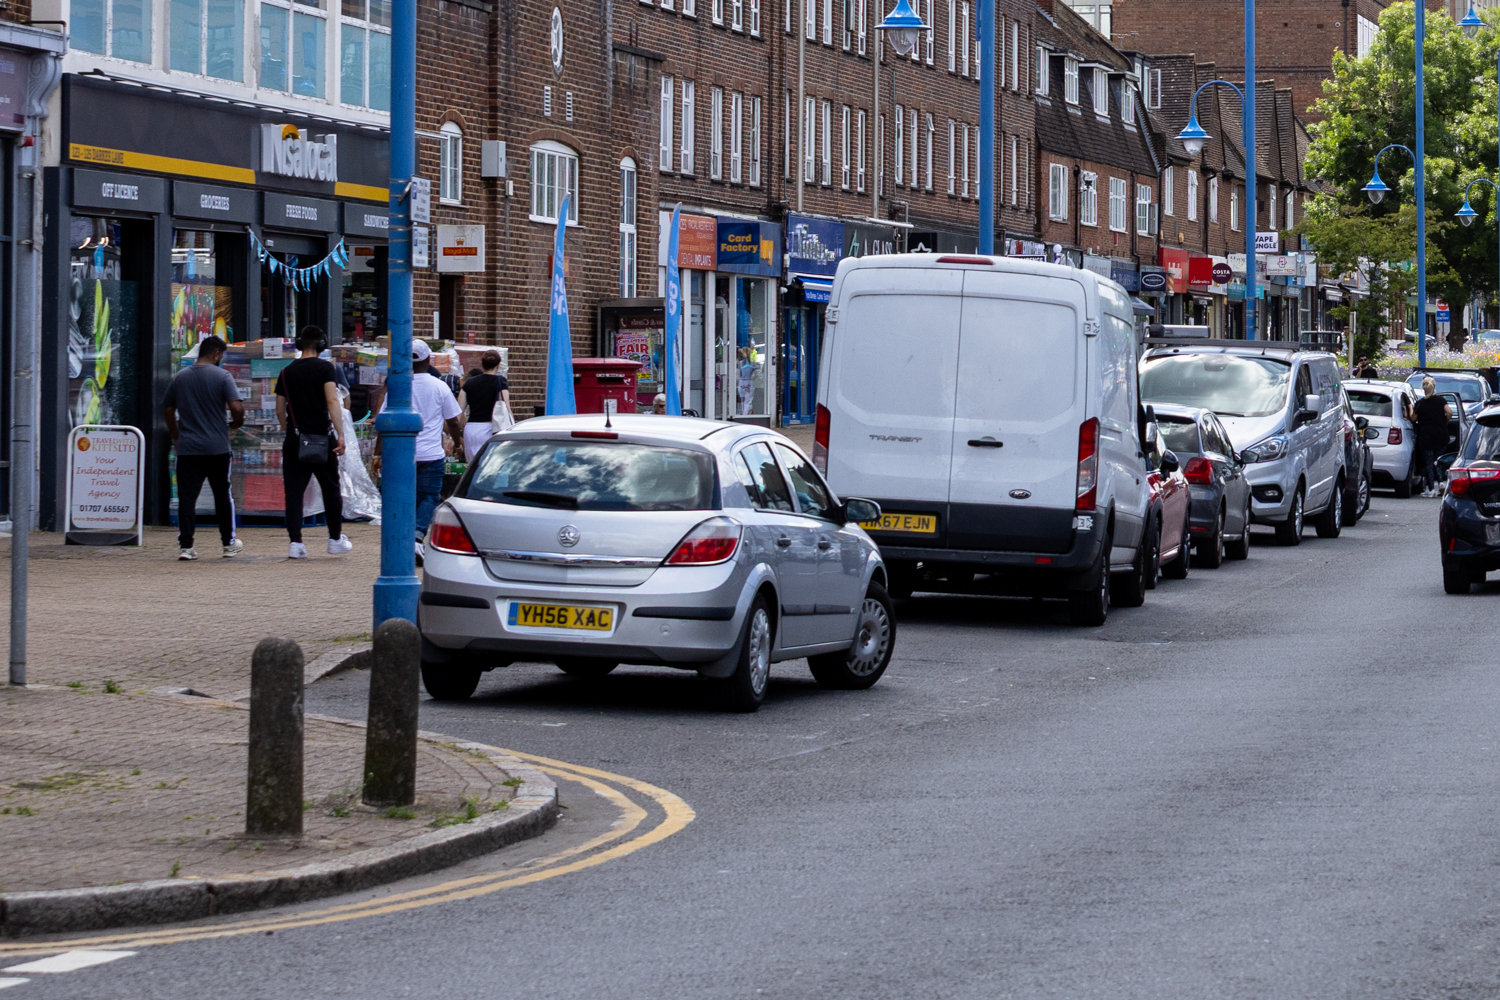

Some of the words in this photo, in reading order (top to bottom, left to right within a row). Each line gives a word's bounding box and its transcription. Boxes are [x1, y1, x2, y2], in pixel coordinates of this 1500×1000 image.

[102, 182, 114, 198] OFF
[114, 184, 139, 200] LICENCE
[201, 194, 230, 211] GROCERIES
[286, 204, 302, 219] FRESH
[302, 206, 318, 221] FOODS
[364, 214, 389, 229] SANDWICHE
[728, 234, 752, 242] Card
[444, 248, 461, 256] Royal
[721, 243, 758, 254] Factory
[618, 343, 649, 356] FAIR
[869, 434, 922, 443] TRANSIT
[95, 456, 117, 464] Your
[76, 466, 135, 477] Independent
[90, 478, 120, 486] Travel
[88, 489, 121, 500] Agency
[79, 504, 102, 512] 01707
[103, 505, 130, 513] 655567
[904, 516, 930, 530] EJN
[522, 605, 568, 625] YH56
[573, 608, 610, 627] XAC
